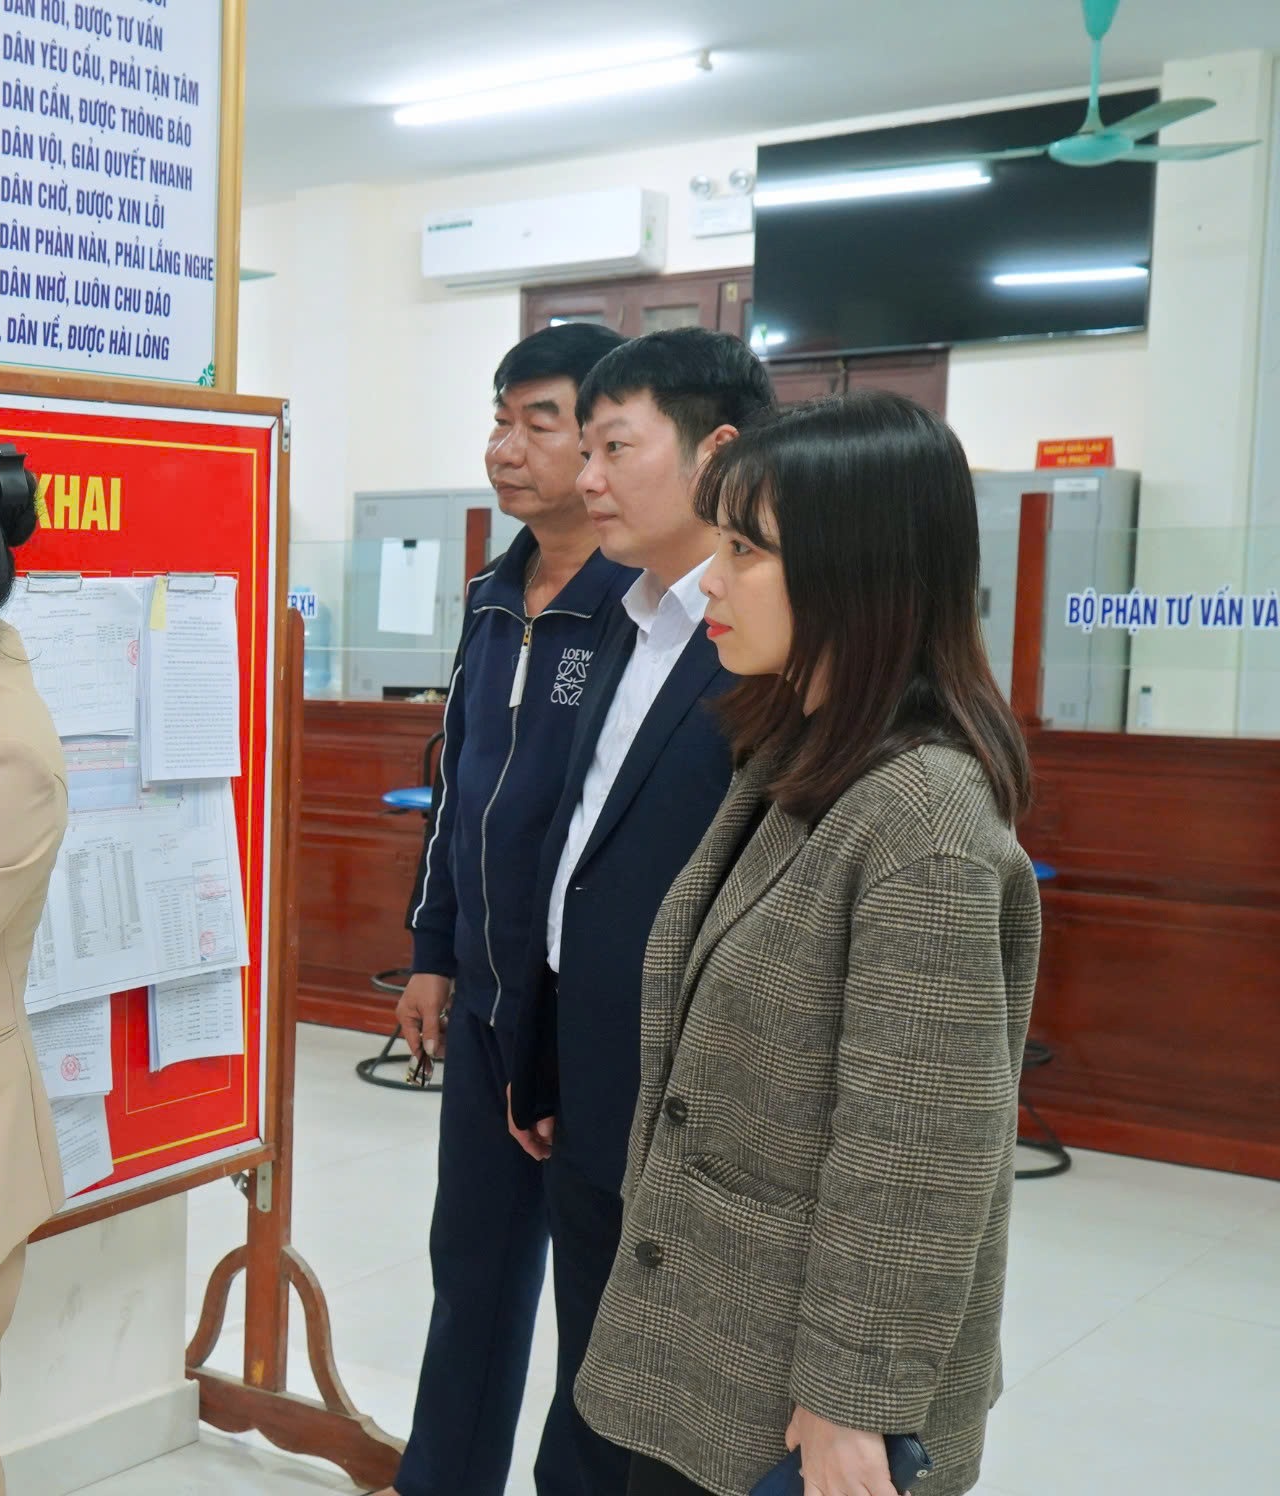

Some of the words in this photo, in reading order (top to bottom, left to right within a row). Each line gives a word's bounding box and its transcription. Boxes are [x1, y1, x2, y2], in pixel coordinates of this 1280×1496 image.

[74, 4, 112, 40] ĐƯỢC
[116, 15, 134, 43] TƯ
[137, 16, 163, 51] VẤN
[3, 31, 35, 66] DÂN
[40, 39, 68, 74] YÊU
[109, 56, 140, 91] PHẢI
[145, 65, 169, 101] TẬN
[173, 73, 199, 106] TÂM
[2, 78, 34, 113] DÂN
[40, 82, 74, 124] CẦN,
[79, 97, 116, 134] ĐƯỢC
[120, 106, 163, 141] THÔNG
[167, 116, 192, 147] BÁO
[1, 125, 33, 160] DÂN
[38, 132, 66, 169] VỘI,
[71, 137, 100, 172] GIẢI
[104, 147, 146, 181] QUYẾT
[149, 158, 192, 191] NHANH
[0, 172, 32, 206] DÂN
[38, 179, 71, 216] CHỜ,
[76, 188, 113, 224] ĐƯỢC
[118, 196, 141, 225] XIN
[145, 194, 164, 229] LỖI
[0, 218, 30, 252] DÂN
[35, 225, 74, 259] PHÀN
[78, 231, 110, 268] NÀN,
[115, 235, 145, 270] PHẢI
[149, 238, 181, 276] LẮNG
[184, 253, 214, 281] NGHE
[0, 265, 31, 299] DÂN
[36, 271, 69, 307] NHỜ,
[74, 277, 110, 309] LUÔN
[114, 285, 141, 313] CHU
[145, 286, 171, 318] ĐÁO
[7, 313, 38, 346] DÂN
[43, 314, 63, 352] VỀ,
[67, 323, 105, 358] ĐƯỢC
[108, 325, 132, 357] HÀI
[135, 328, 170, 360] LÒNG
[35, 473, 121, 531] KHAI
[288, 594, 316, 617] BXH
[1068, 589, 1095, 631] BỘ
[1101, 589, 1158, 632] PHẬN
[1165, 594, 1193, 626] TƯ
[1200, 586, 1243, 627] VẤN
[1253, 591, 1280, 627] VÀ
[561, 647, 593, 662] LOEW
